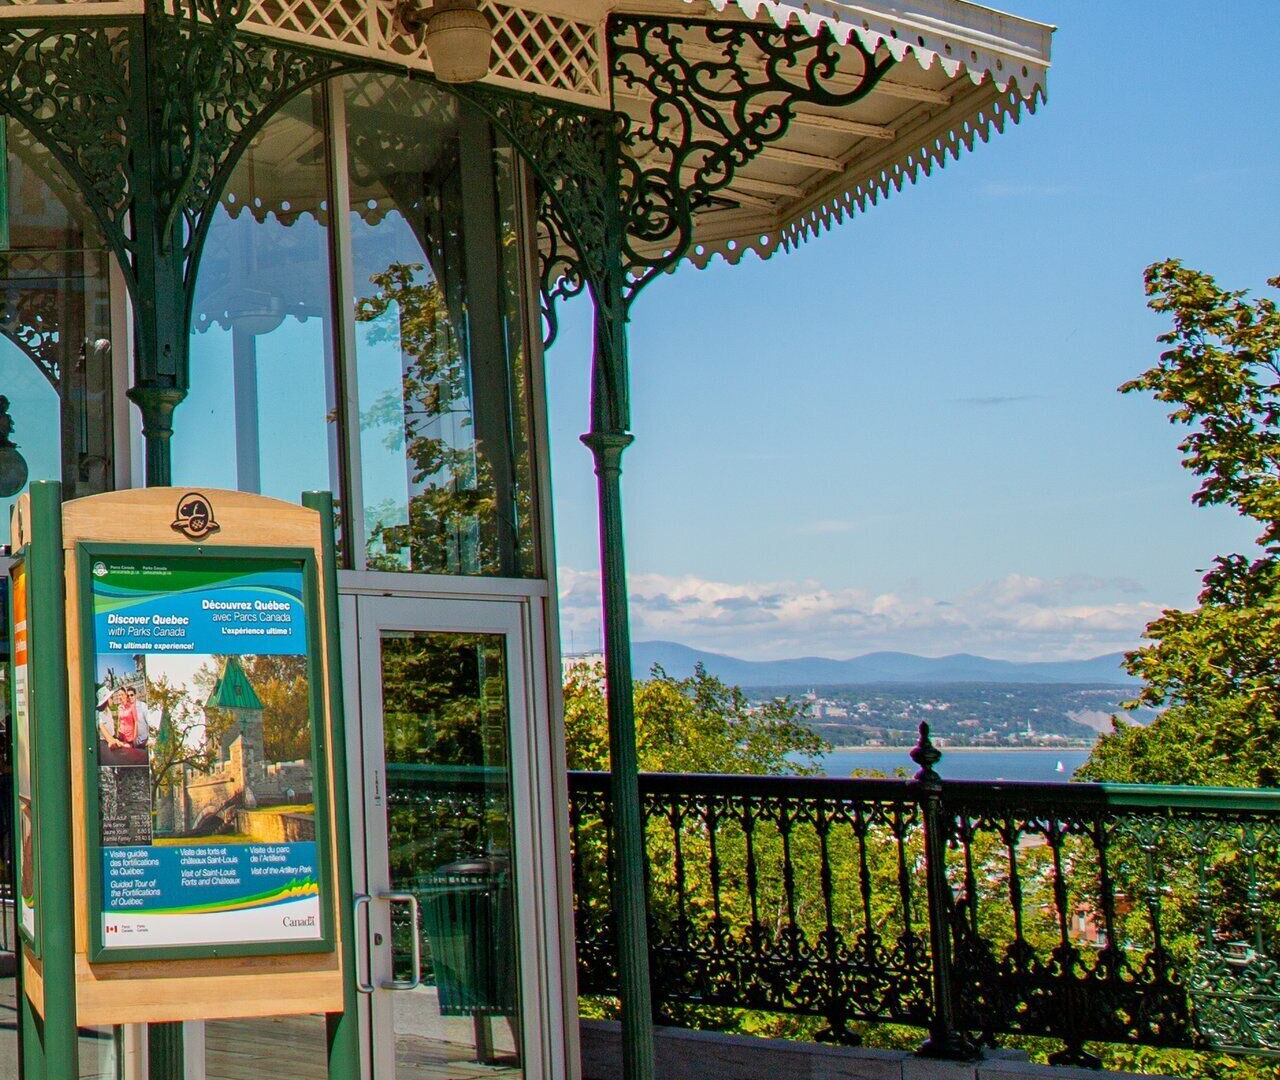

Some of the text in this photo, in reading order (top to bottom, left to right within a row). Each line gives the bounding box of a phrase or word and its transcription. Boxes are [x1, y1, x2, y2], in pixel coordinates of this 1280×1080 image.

[202, 600, 291, 610] Découvrez Québec
[108, 613, 189, 625] Discover Quebec
[212, 612, 291, 622] avec Parcs Canada
[108, 626, 185, 637] with Parks Canada
[221, 627, 264, 635] L'expérience
[266, 627, 288, 635] ultime
[109, 641, 122, 649] The
[154, 642, 194, 650] experience!
[110, 849, 148, 859] Visite guidée
[180, 848, 195, 856] Visite
[195, 848, 207, 856] des
[207, 847, 220, 855] forts
[250, 846, 266, 854] Visite
[276, 846, 290, 854] parc
[110, 858, 160, 867] des fortifications
[180, 855, 238, 864] châteaux Saint-Louis
[250, 855, 259, 863] de
[110, 868, 119, 876] de
[181, 868, 236, 877] Visit of Saint-Louis
[251, 867, 262, 875] Visit
[262, 866, 269, 874] of
[299, 865, 312, 873] Park
[111, 879, 156, 888] Guided Tour of
[182, 878, 197, 886] Forts
[198, 878, 210, 886] and
[111, 888, 161, 897] the Fortifications
[111, 898, 118, 906] of
[283, 916, 315, 927] Canada
